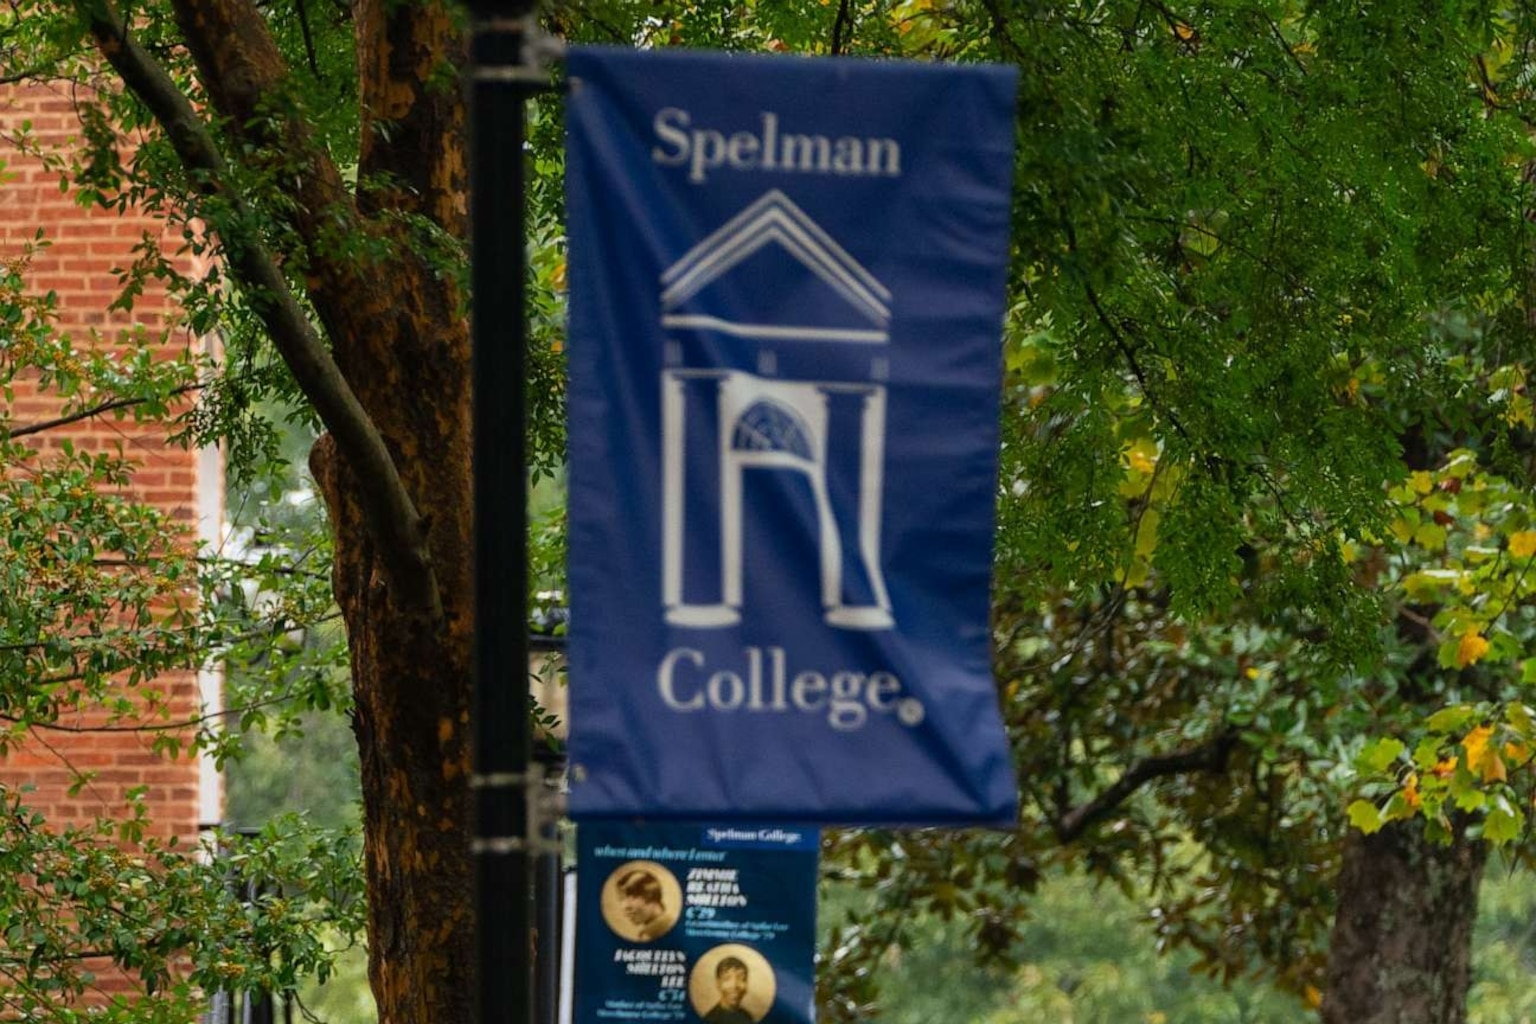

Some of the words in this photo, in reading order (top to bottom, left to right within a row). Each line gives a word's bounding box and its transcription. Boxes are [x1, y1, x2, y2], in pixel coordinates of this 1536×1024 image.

[652, 107, 902, 184] Spelman
[707, 828, 757, 842] Spelman
[758, 829, 803, 844] College
